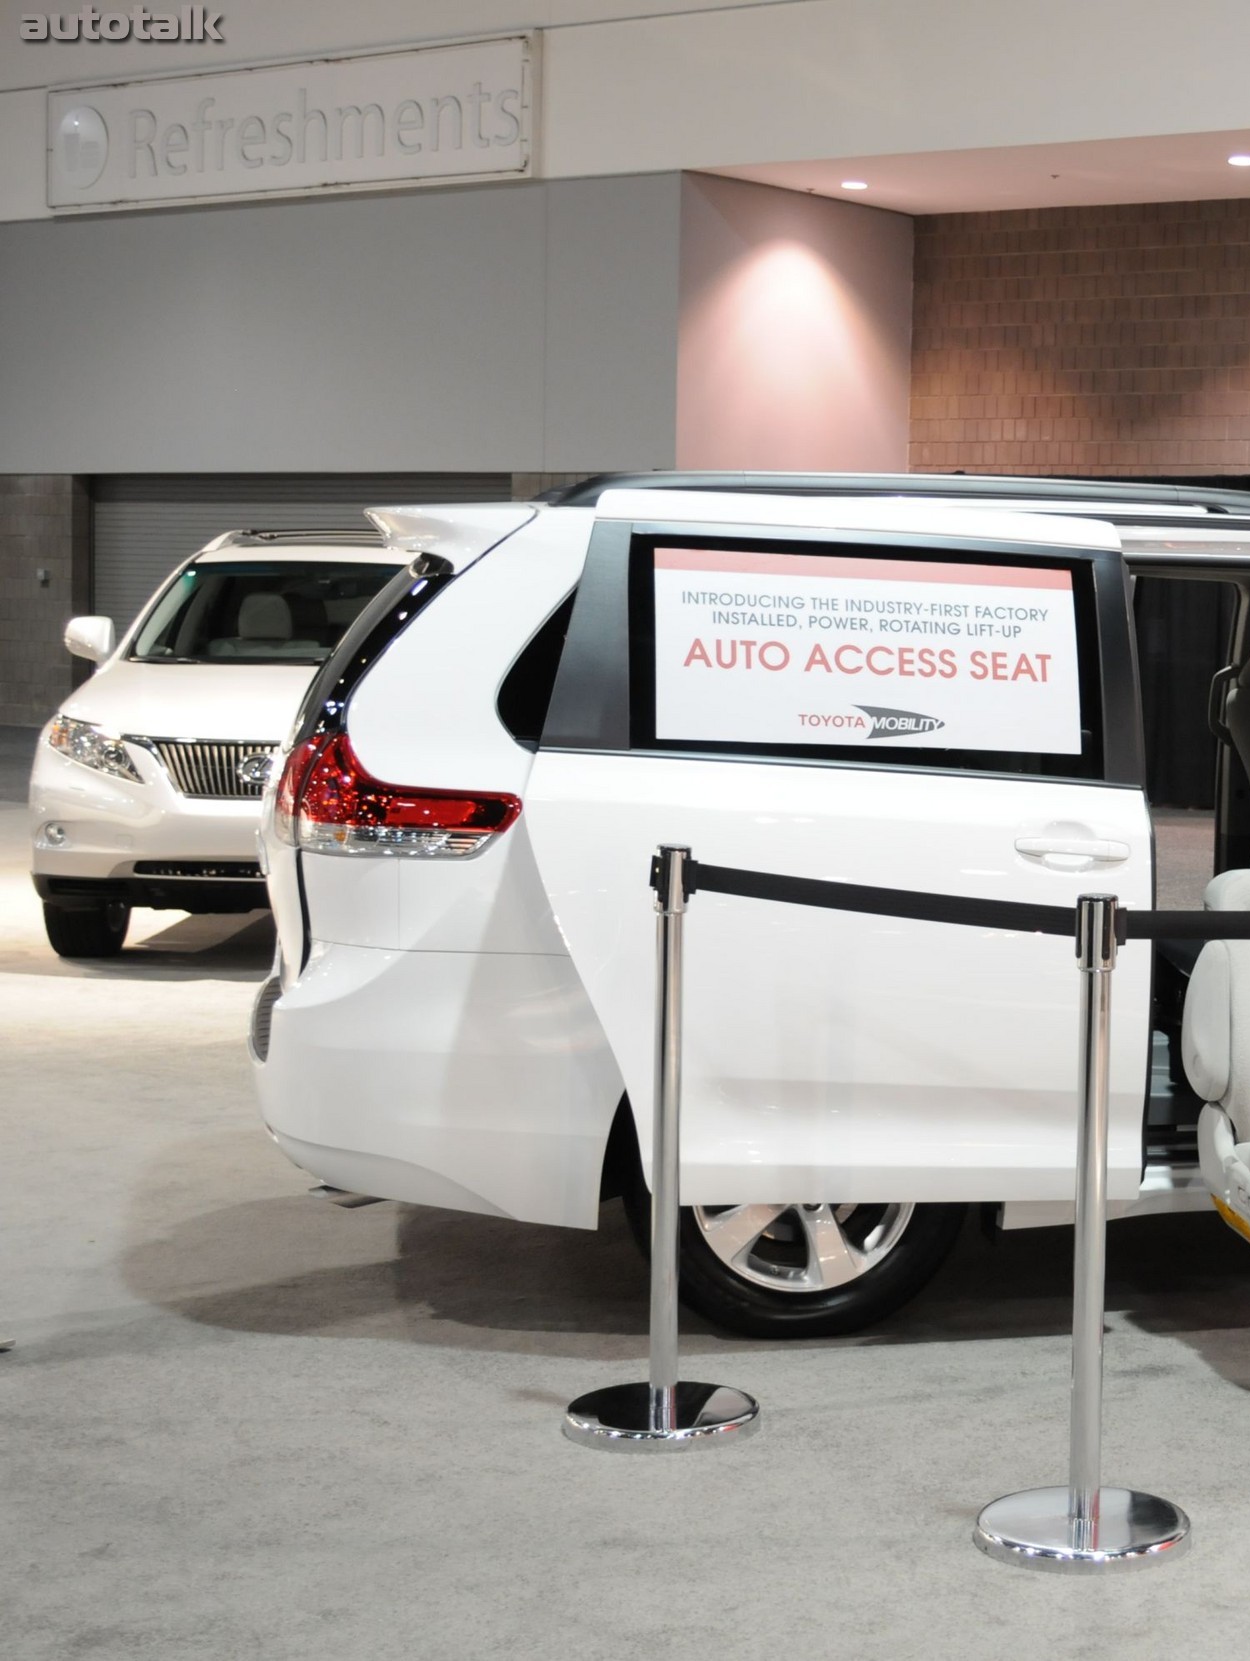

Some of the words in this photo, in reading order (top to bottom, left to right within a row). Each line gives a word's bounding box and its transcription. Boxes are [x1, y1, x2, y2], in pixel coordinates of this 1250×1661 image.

[127, 82, 521, 179] Refreshments
[681, 590, 806, 610] INTRODUCING
[811, 597, 839, 611] THE
[845, 599, 970, 618] INDUSTRY-FIRST
[975, 605, 1049, 622] FACTORY
[712, 611, 803, 630] INSTALLED,
[808, 615, 874, 633] POWER,
[879, 618, 961, 636] ROTATING
[966, 623, 1022, 639] LIFT-UP
[683, 638, 791, 672] AUTO
[803, 643, 958, 679] ACCESS
[969, 650, 1052, 683] SEAT
[798, 714, 866, 729] TOYOTA
[870, 716, 943, 732] MOBILITY
